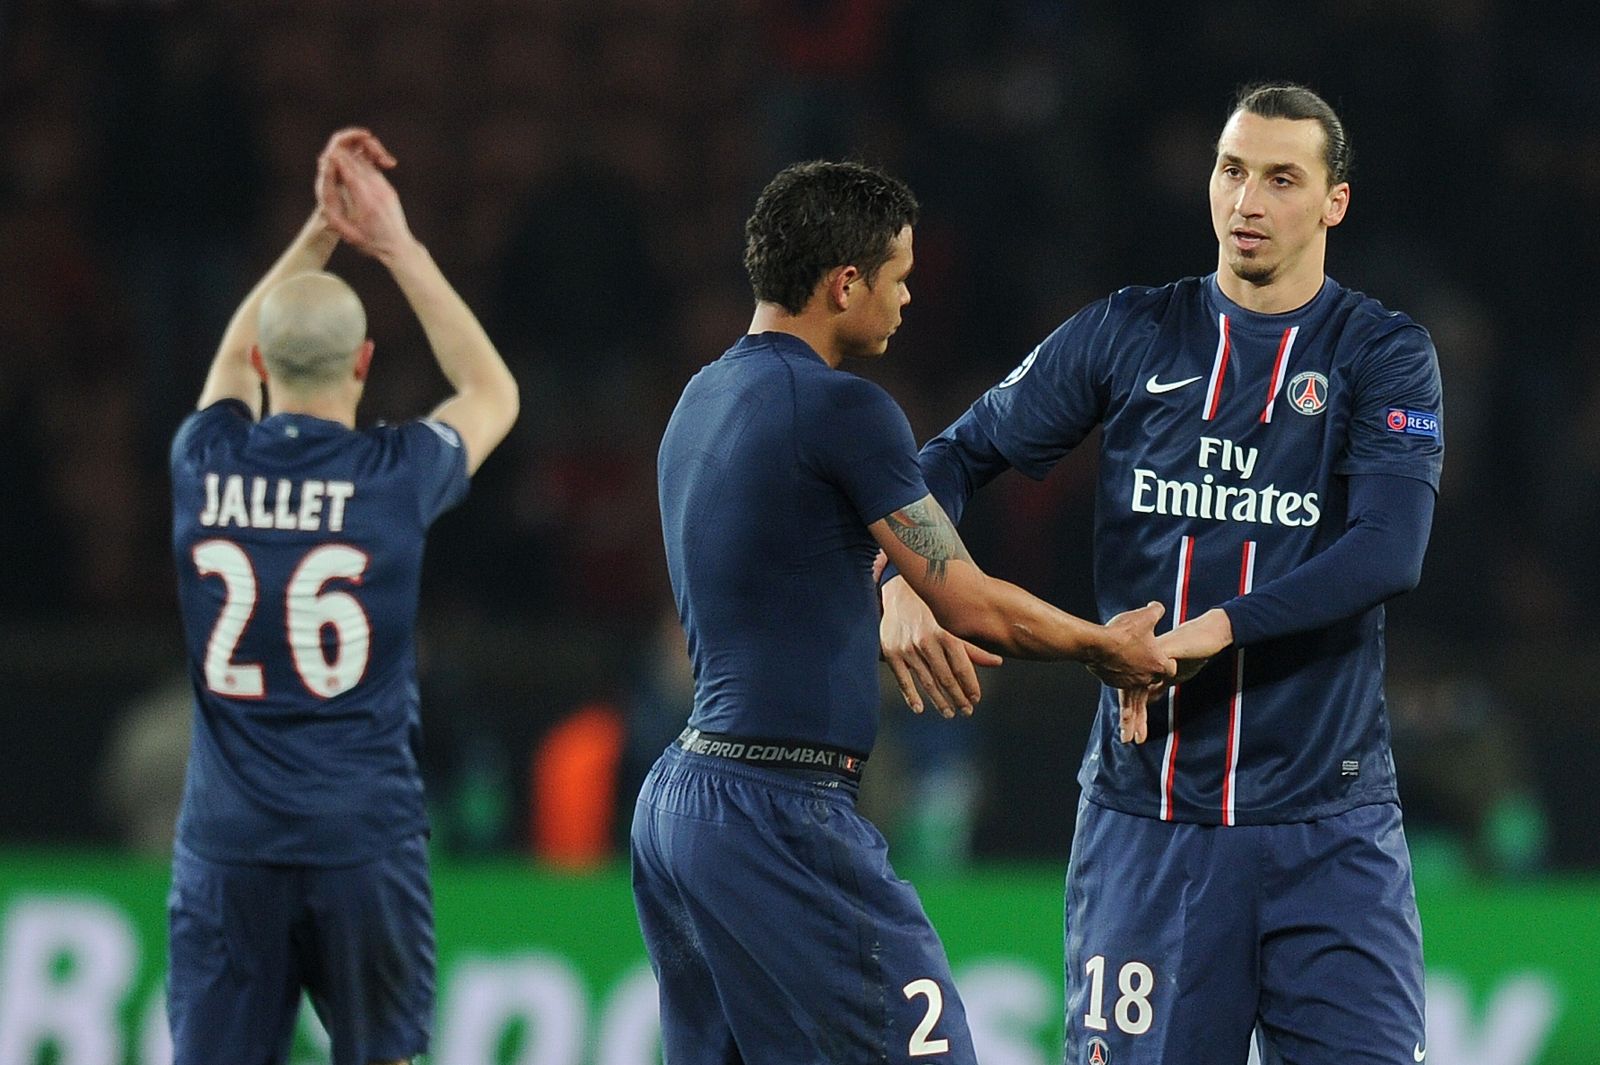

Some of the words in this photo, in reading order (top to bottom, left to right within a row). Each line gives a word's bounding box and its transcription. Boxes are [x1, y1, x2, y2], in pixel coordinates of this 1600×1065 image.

[1198, 436, 1258, 480] Fly
[200, 472, 355, 532] JALLET
[1131, 468, 1321, 527] Emirates
[192, 537, 371, 700] 26
[745, 744, 836, 767] COMBAT
[902, 977, 949, 1057] 2
[1083, 953, 1155, 1035] 18
